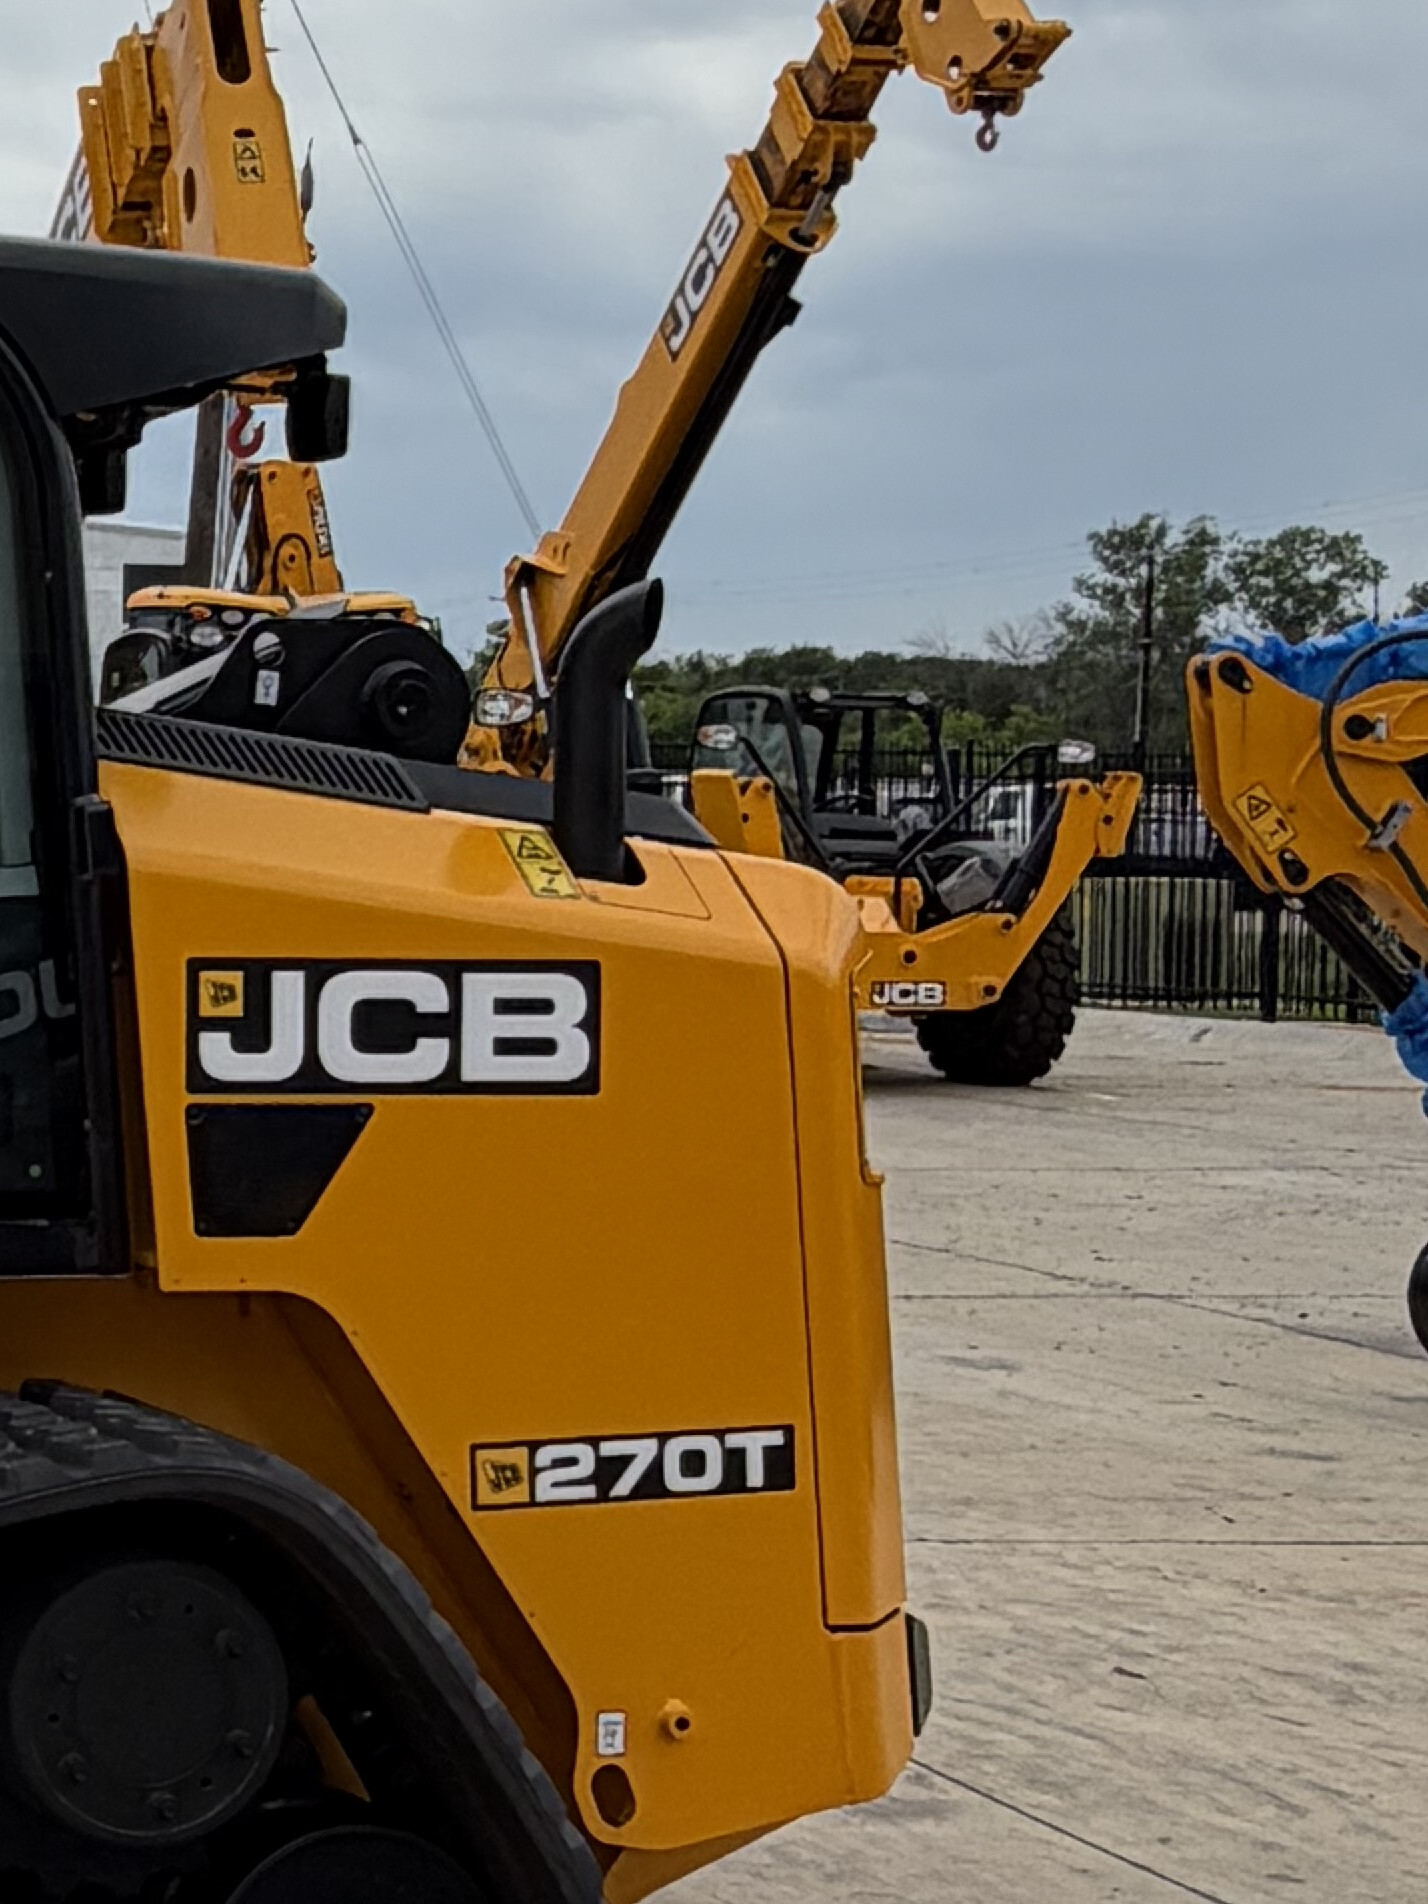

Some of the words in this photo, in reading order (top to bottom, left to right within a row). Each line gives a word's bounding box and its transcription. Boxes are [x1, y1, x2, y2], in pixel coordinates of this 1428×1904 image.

[669, 198, 740, 352] JCB
[198, 970, 590, 1082] JCB
[872, 982, 944, 1004] JCB
[535, 1429, 785, 1503] 270T
